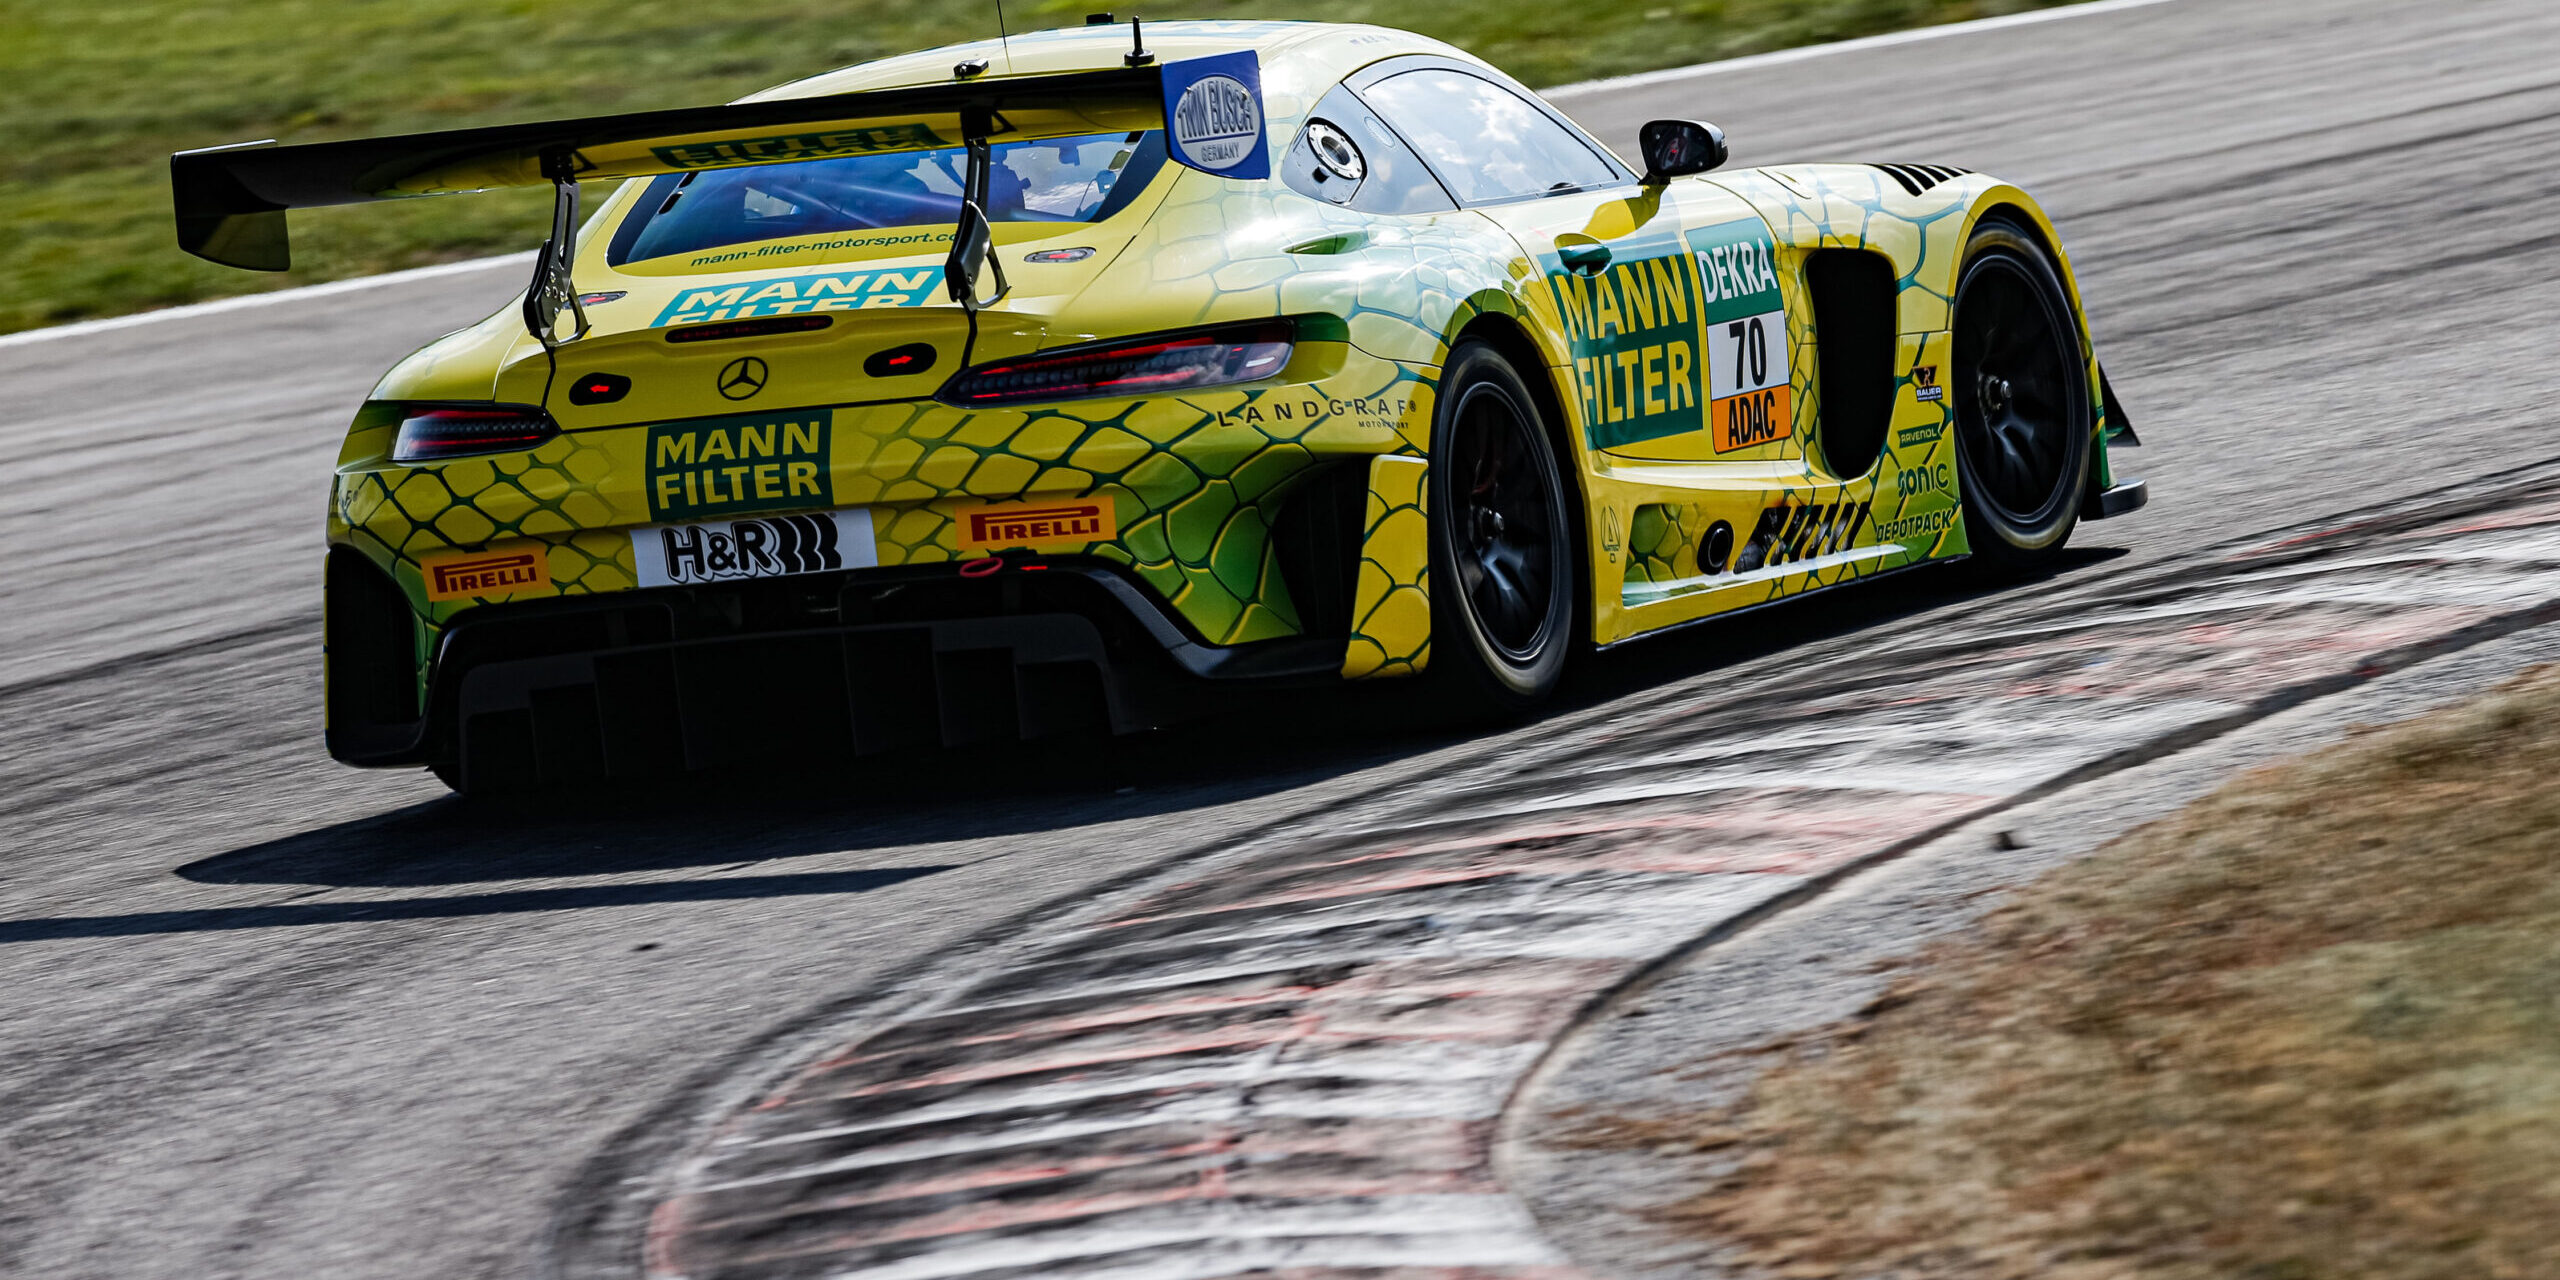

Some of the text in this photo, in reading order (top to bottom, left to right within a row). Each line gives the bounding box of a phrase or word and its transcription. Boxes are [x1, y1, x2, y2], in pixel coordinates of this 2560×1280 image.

[1177, 80, 1254, 139] TWIN BUSCH
[1201, 142, 1239, 162] GERMANY
[677, 270, 933, 312] MANN
[1695, 237, 1778, 304] DEKRA
[1554, 254, 1689, 342] MANN
[1728, 317, 1767, 390] 70
[1575, 340, 1695, 428] FILTER
[656, 421, 820, 469] MANN
[1728, 390, 1776, 448] ADAC
[656, 461, 822, 510] FILTER
[970, 505, 1100, 542] PIRELLI
[1876, 509, 1952, 543] DEPOTPACK
[433, 554, 537, 594] PIRELLI
[661, 520, 782, 584] H&R
